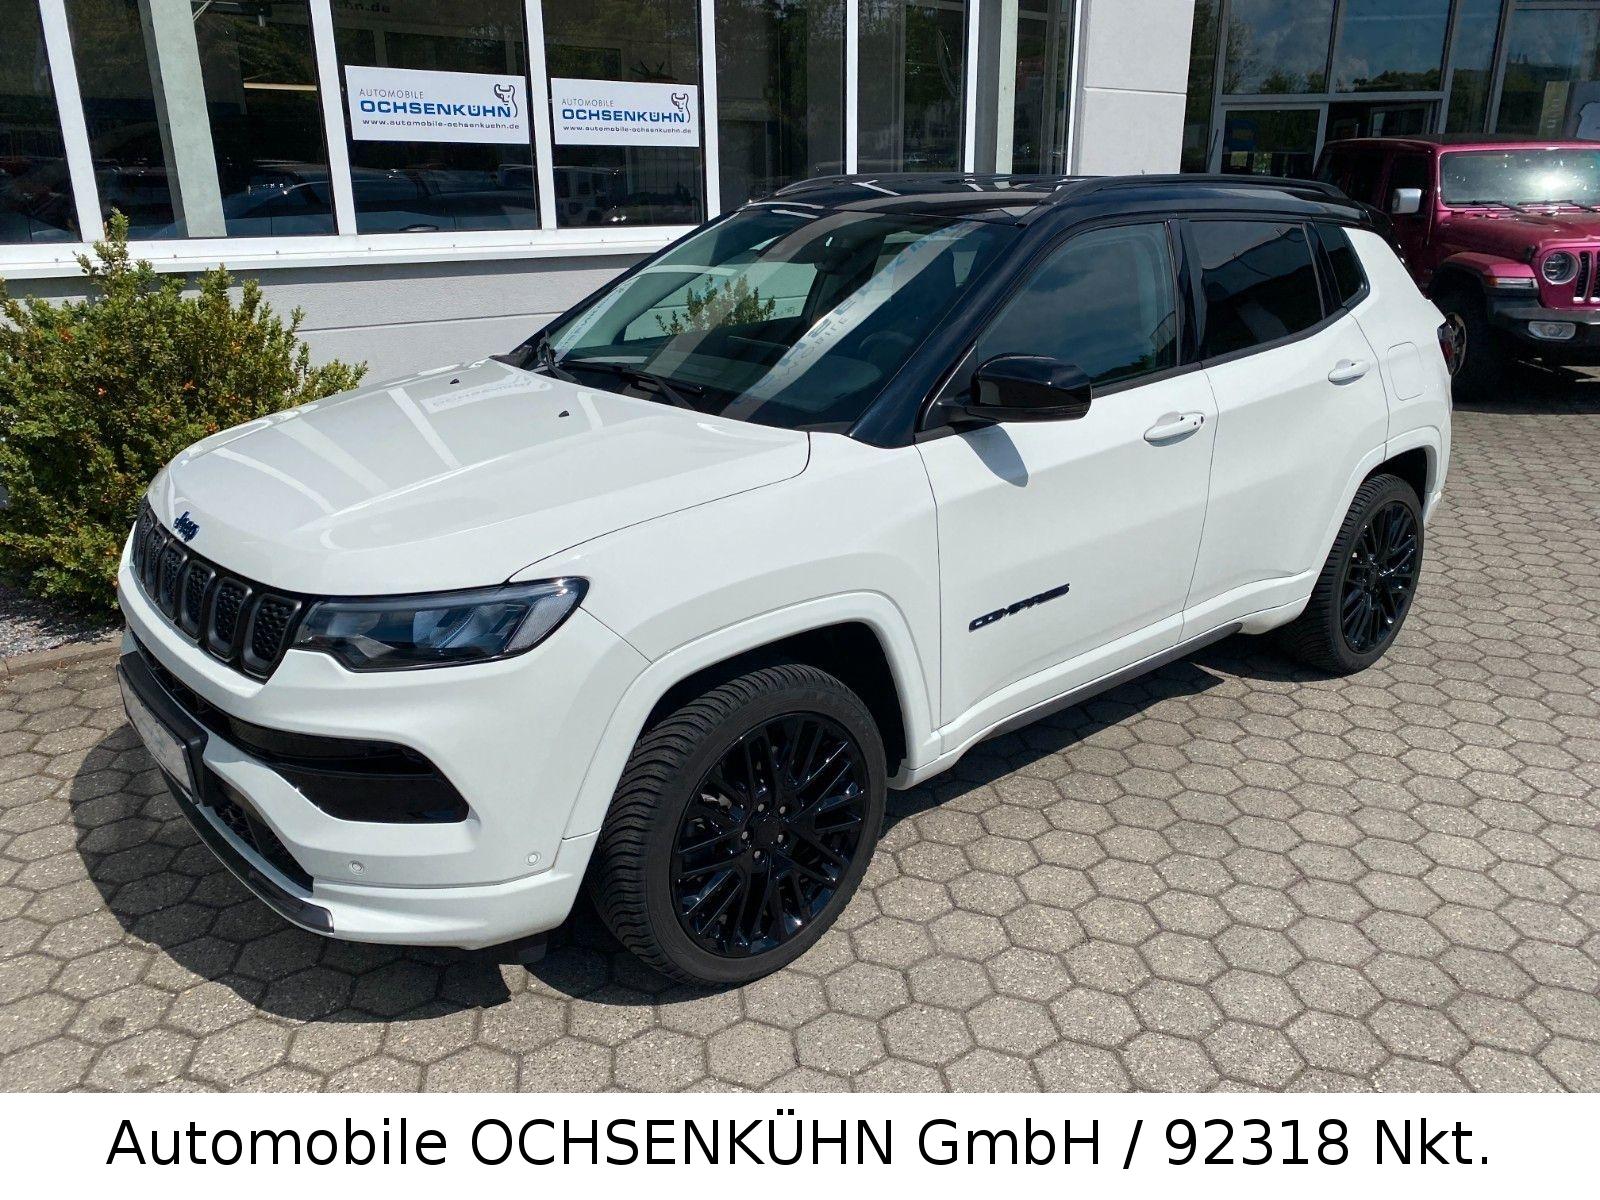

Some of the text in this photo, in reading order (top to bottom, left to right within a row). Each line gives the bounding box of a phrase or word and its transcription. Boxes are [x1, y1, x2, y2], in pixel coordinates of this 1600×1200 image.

[359, 88, 425, 100] AUTOMOBILE
[360, 99, 512, 118] OCHSENKÜHN
[561, 98, 614, 108] AUTOMOBILE
[562, 108, 685, 123] OCHSENKÜHN
[362, 118, 520, 130] www.automobile-ochsenkuehn.de
[563, 125, 692, 135] www.automobile-ochsenkuehn.de
